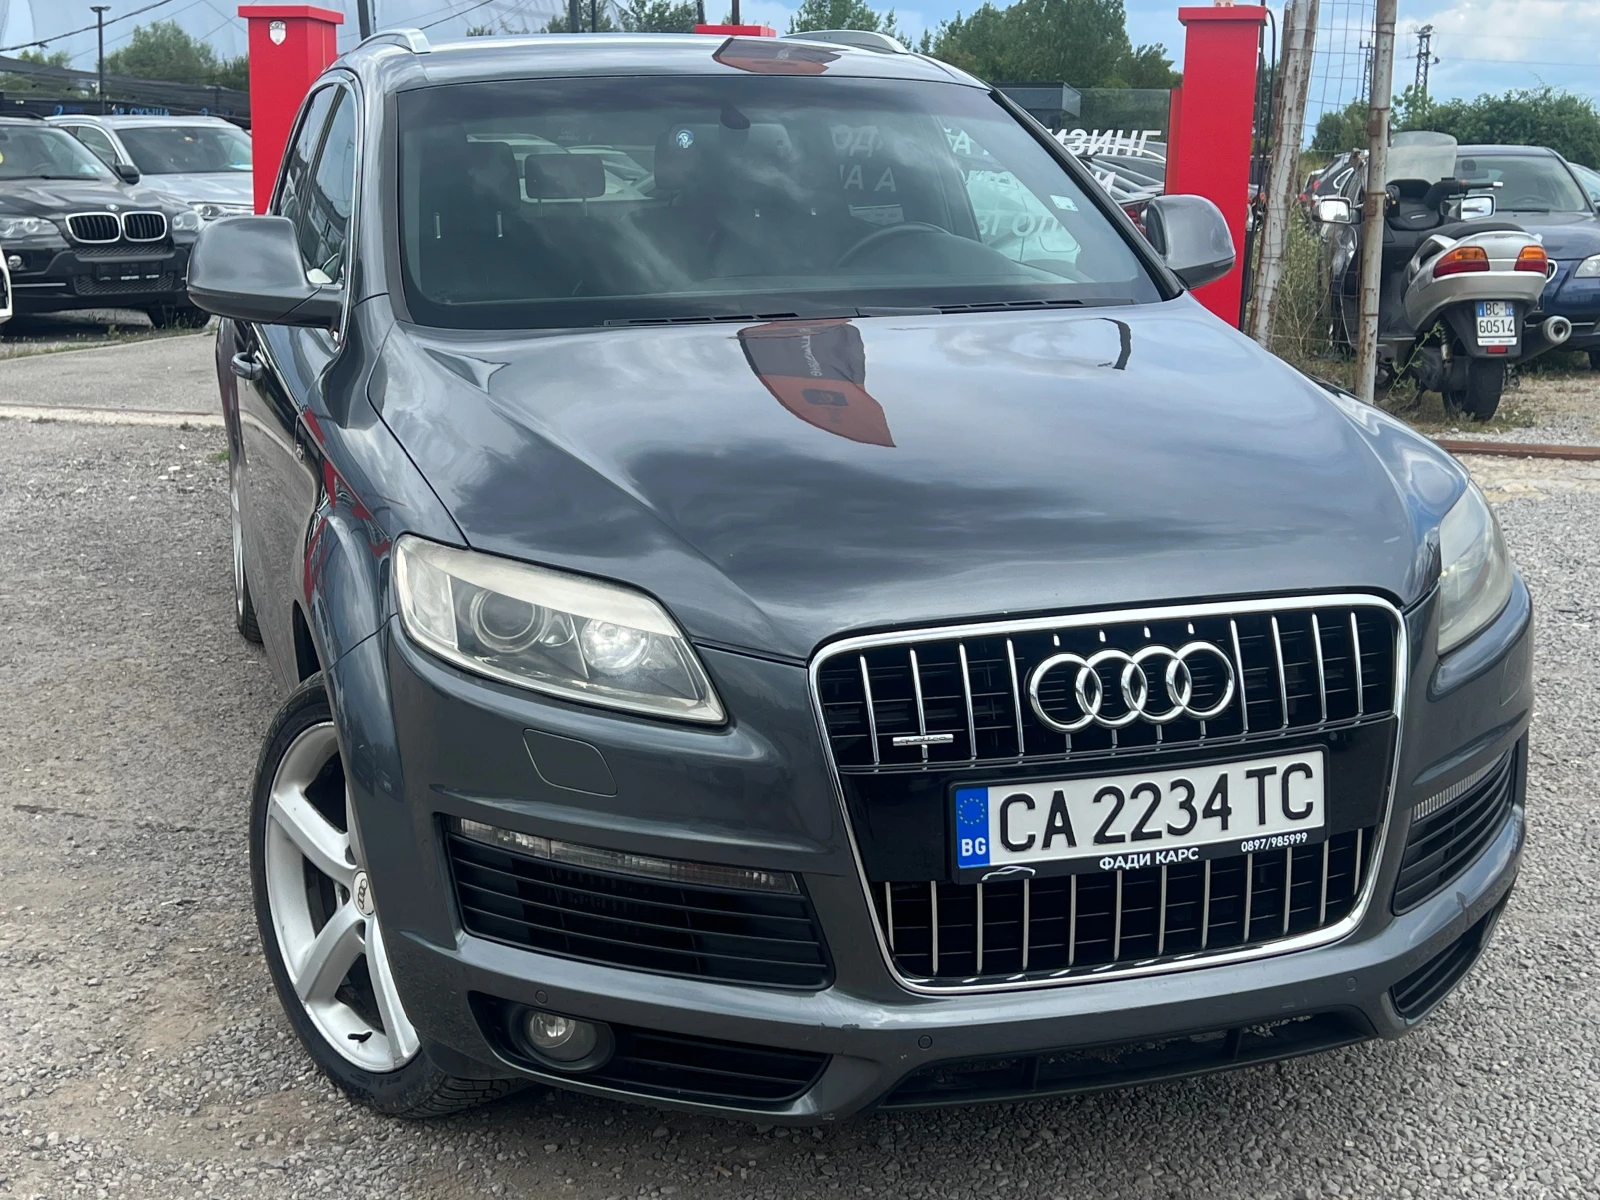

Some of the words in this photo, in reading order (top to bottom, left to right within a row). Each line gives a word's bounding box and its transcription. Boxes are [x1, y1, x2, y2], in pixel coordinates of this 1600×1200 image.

[1046, 128, 1161, 156] ИЗИНГ
[1485, 302, 1499, 316] BC
[1479, 319, 1514, 334] 60514
[1000, 789, 1077, 852] CA
[1093, 772, 1232, 845] 2234
[1245, 762, 1314, 826] TC
[961, 837, 987, 857] BG
[1240, 831, 1308, 853] 0897/985999
[1099, 852, 1151, 870] ФАДИ
[1155, 847, 1200, 865] КАРС
